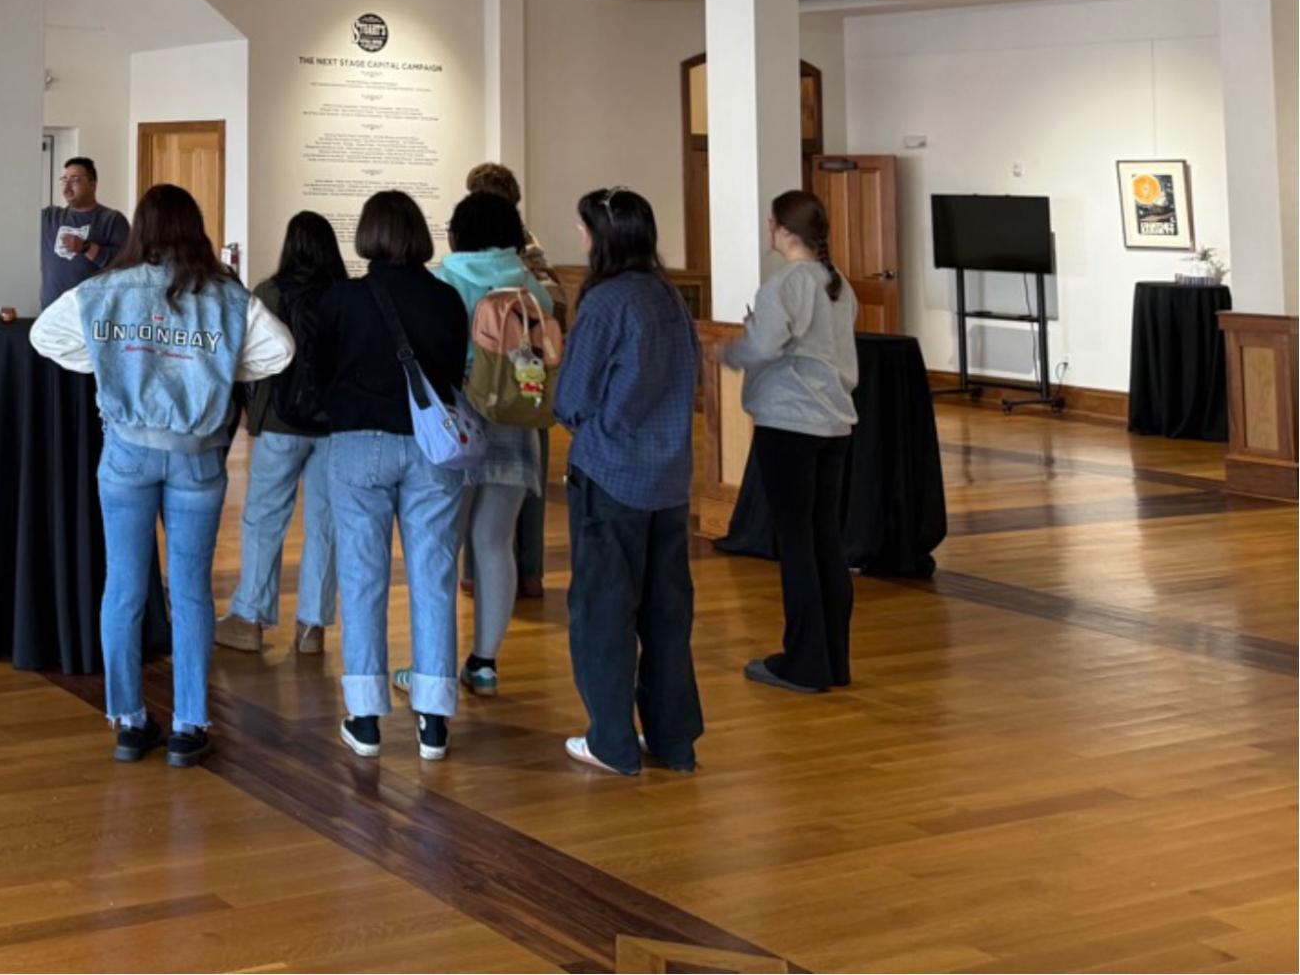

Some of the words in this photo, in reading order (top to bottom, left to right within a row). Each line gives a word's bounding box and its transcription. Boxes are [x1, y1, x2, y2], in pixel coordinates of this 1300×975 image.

[298, 56, 314, 65] THE
[316, 58, 337, 66] NEXT
[339, 59, 365, 68] STAGE
[367, 61, 399, 70] CAPITAL
[401, 63, 443, 72] CAMPAIGN
[93, 320, 223, 354] UNIONBAY
